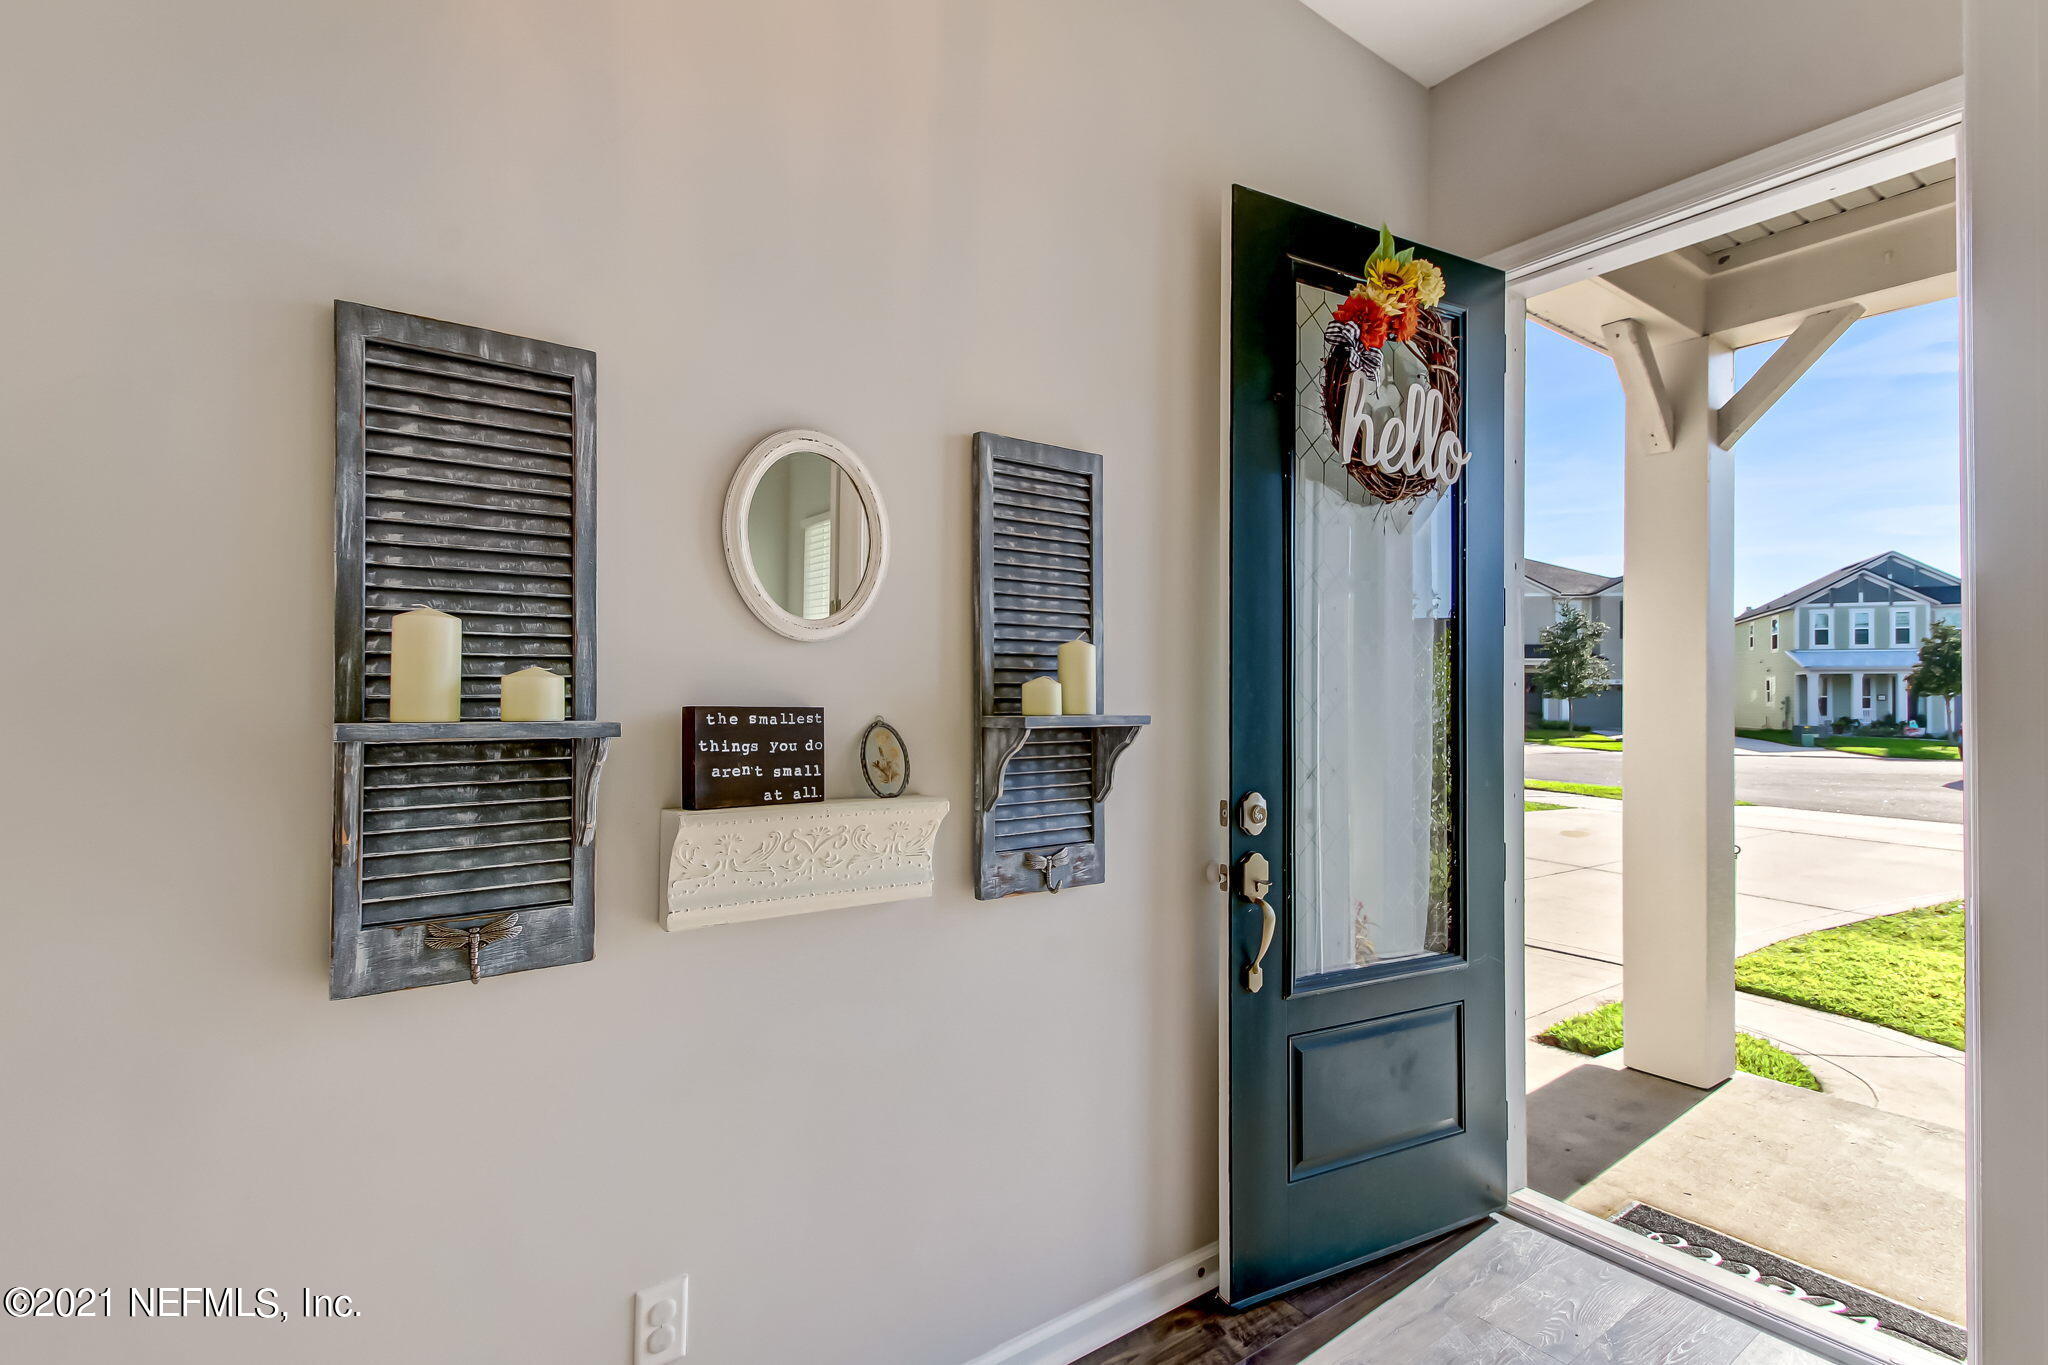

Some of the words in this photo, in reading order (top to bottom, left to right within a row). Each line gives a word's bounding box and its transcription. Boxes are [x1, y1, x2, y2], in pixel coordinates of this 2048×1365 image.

[1340, 369, 1473, 485] hello
[705, 712, 739, 726] the
[748, 712, 823, 725] smallest
[698, 739, 759, 756] things
[769, 741, 798, 754] you
[804, 739, 823, 751] do
[711, 765, 763, 778] aren't
[773, 764, 822, 778] small
[763, 789, 783, 801] at
[793, 786, 822, 800] all.
